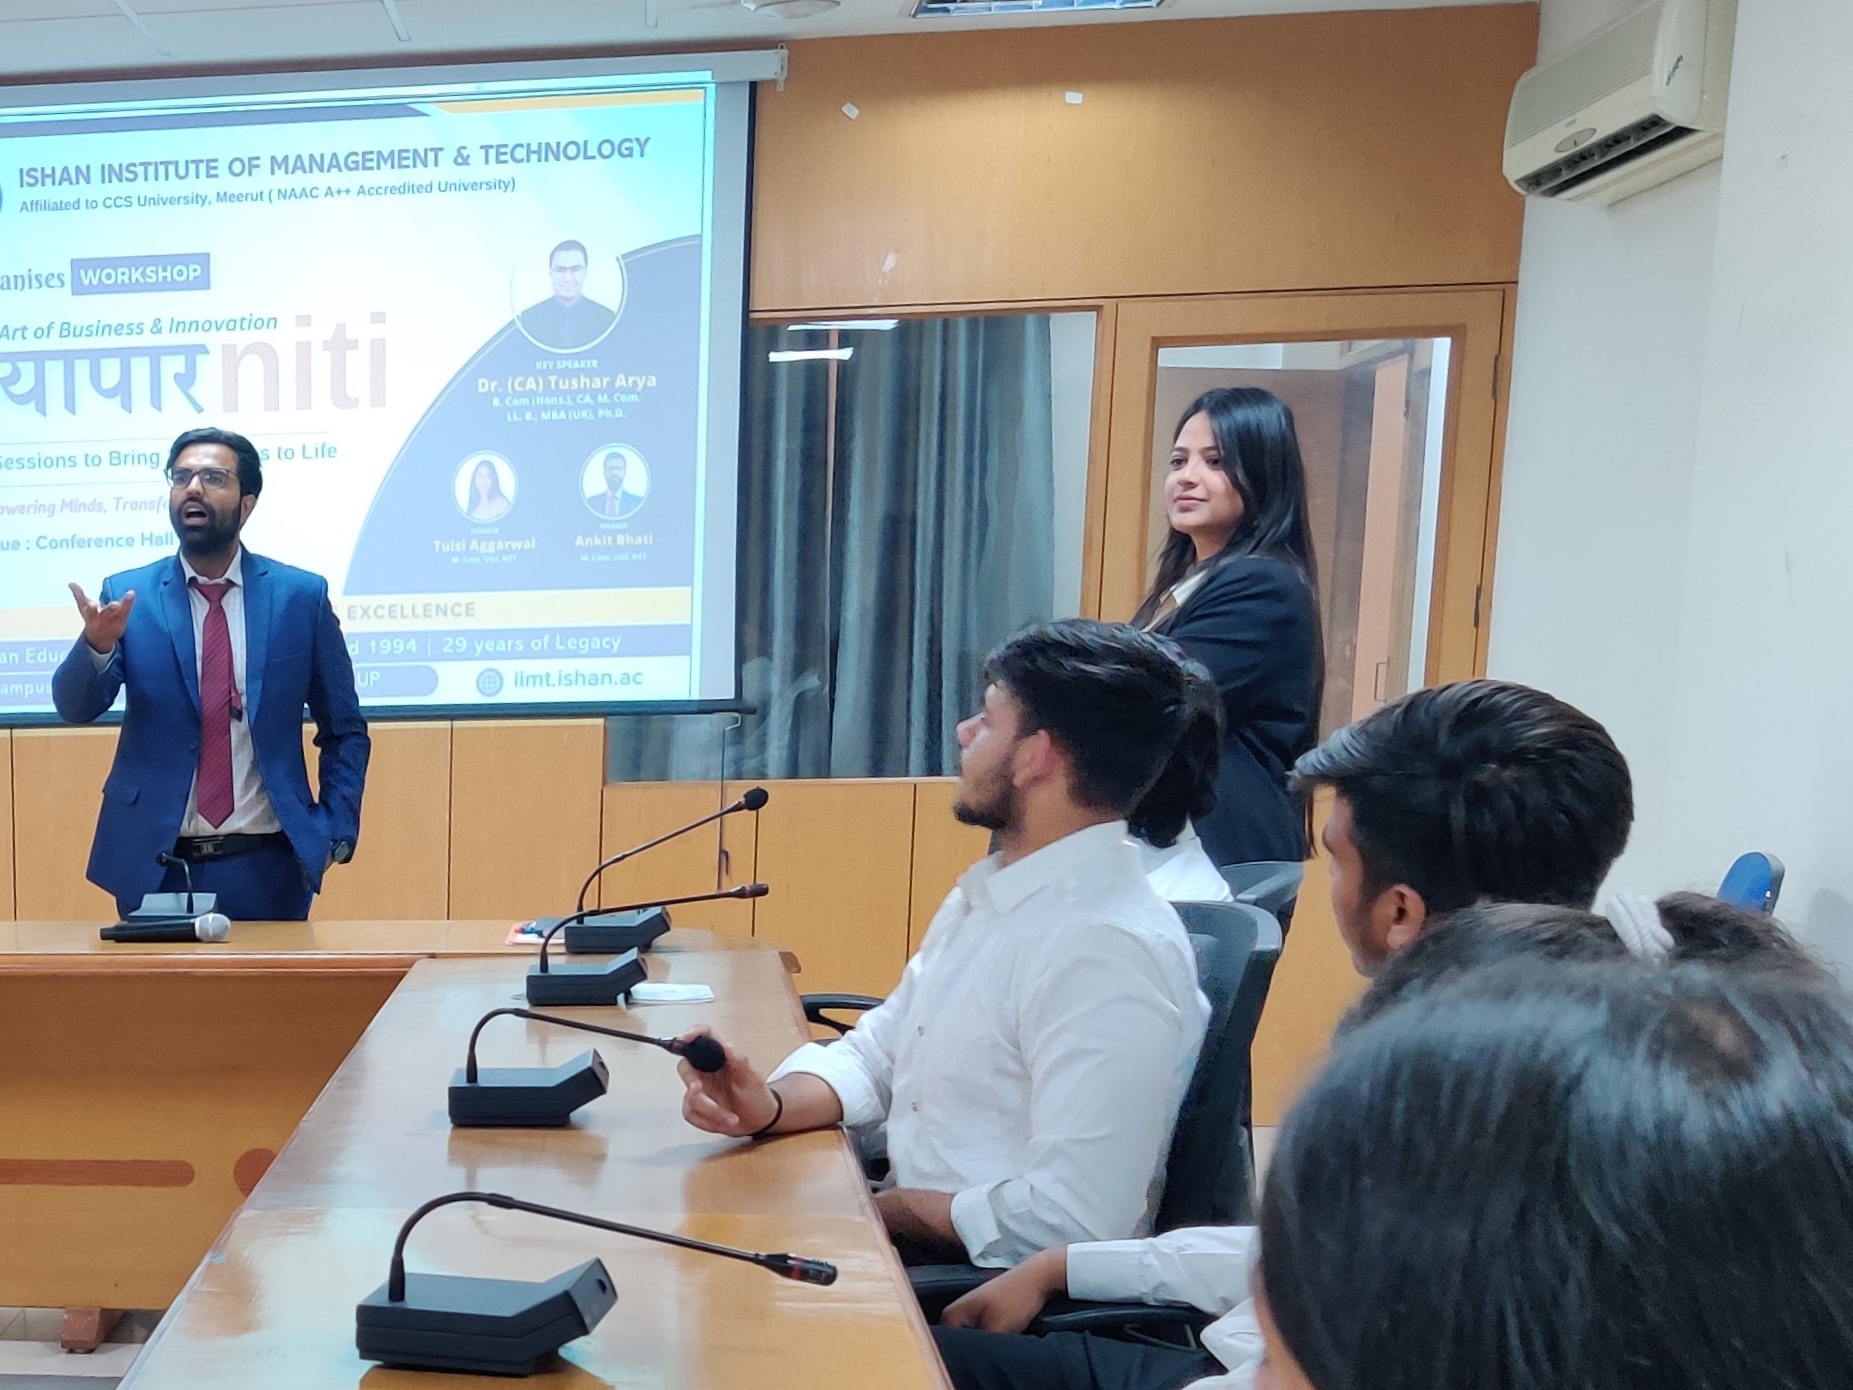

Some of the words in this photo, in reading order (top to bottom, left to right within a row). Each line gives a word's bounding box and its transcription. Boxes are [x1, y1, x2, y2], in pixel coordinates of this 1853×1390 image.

[19, 164, 91, 188] ISHAN
[100, 158, 219, 184] INSTITUTE
[228, 156, 261, 178] OF
[269, 147, 445, 176] MANAGEMENT
[453, 146, 471, 167] &
[479, 137, 651, 165] TECHNOLOGY
[19, 198, 81, 213] Affiliated
[85, 198, 98, 210] to
[102, 195, 133, 209] CCS
[138, 192, 212, 208] University,
[216, 189, 264, 204] Meerut
[277, 186, 320, 201] NAAC
[324, 184, 352, 198] A++
[356, 181, 433, 197] Accredited
[438, 176, 516, 194] University)
[79, 263, 202, 286] WORKSHOP
[33, 321, 55, 340] of
[59, 318, 145, 339] Business
[149, 317, 162, 335] &
[168, 314, 278, 335] Innovation
[536, 361, 553, 370] KEY
[556, 359, 598, 369] SPEAKER
[478, 378, 502, 393] Dr.
[507, 376, 543, 394] (CA)
[549, 373, 610, 390] Tushar
[615, 373, 657, 391] Arya
[505, 396, 530, 407] Com
[614, 392, 641, 403] Com.
[541, 410, 566, 421] MBA
[84, 450, 102, 467] to
[109, 449, 160, 469] Bring
[277, 446, 295, 461] to
[301, 441, 338, 459] Life
[60, 496, 108, 515] Minds,
[35, 532, 135, 551] Conference
[141, 531, 174, 546] Hall
[433, 538, 467, 552] Tulsi
[469, 537, 536, 554] Aggarwal
[574, 534, 612, 547] Ankit
[616, 533, 654, 546] Bhati
[347, 602, 476, 621] EXCELLENCE
[369, 638, 417, 655] 1994
[442, 637, 468, 653] 29
[473, 637, 524, 656] years
[530, 635, 549, 651] of
[555, 634, 622, 654] Legacy
